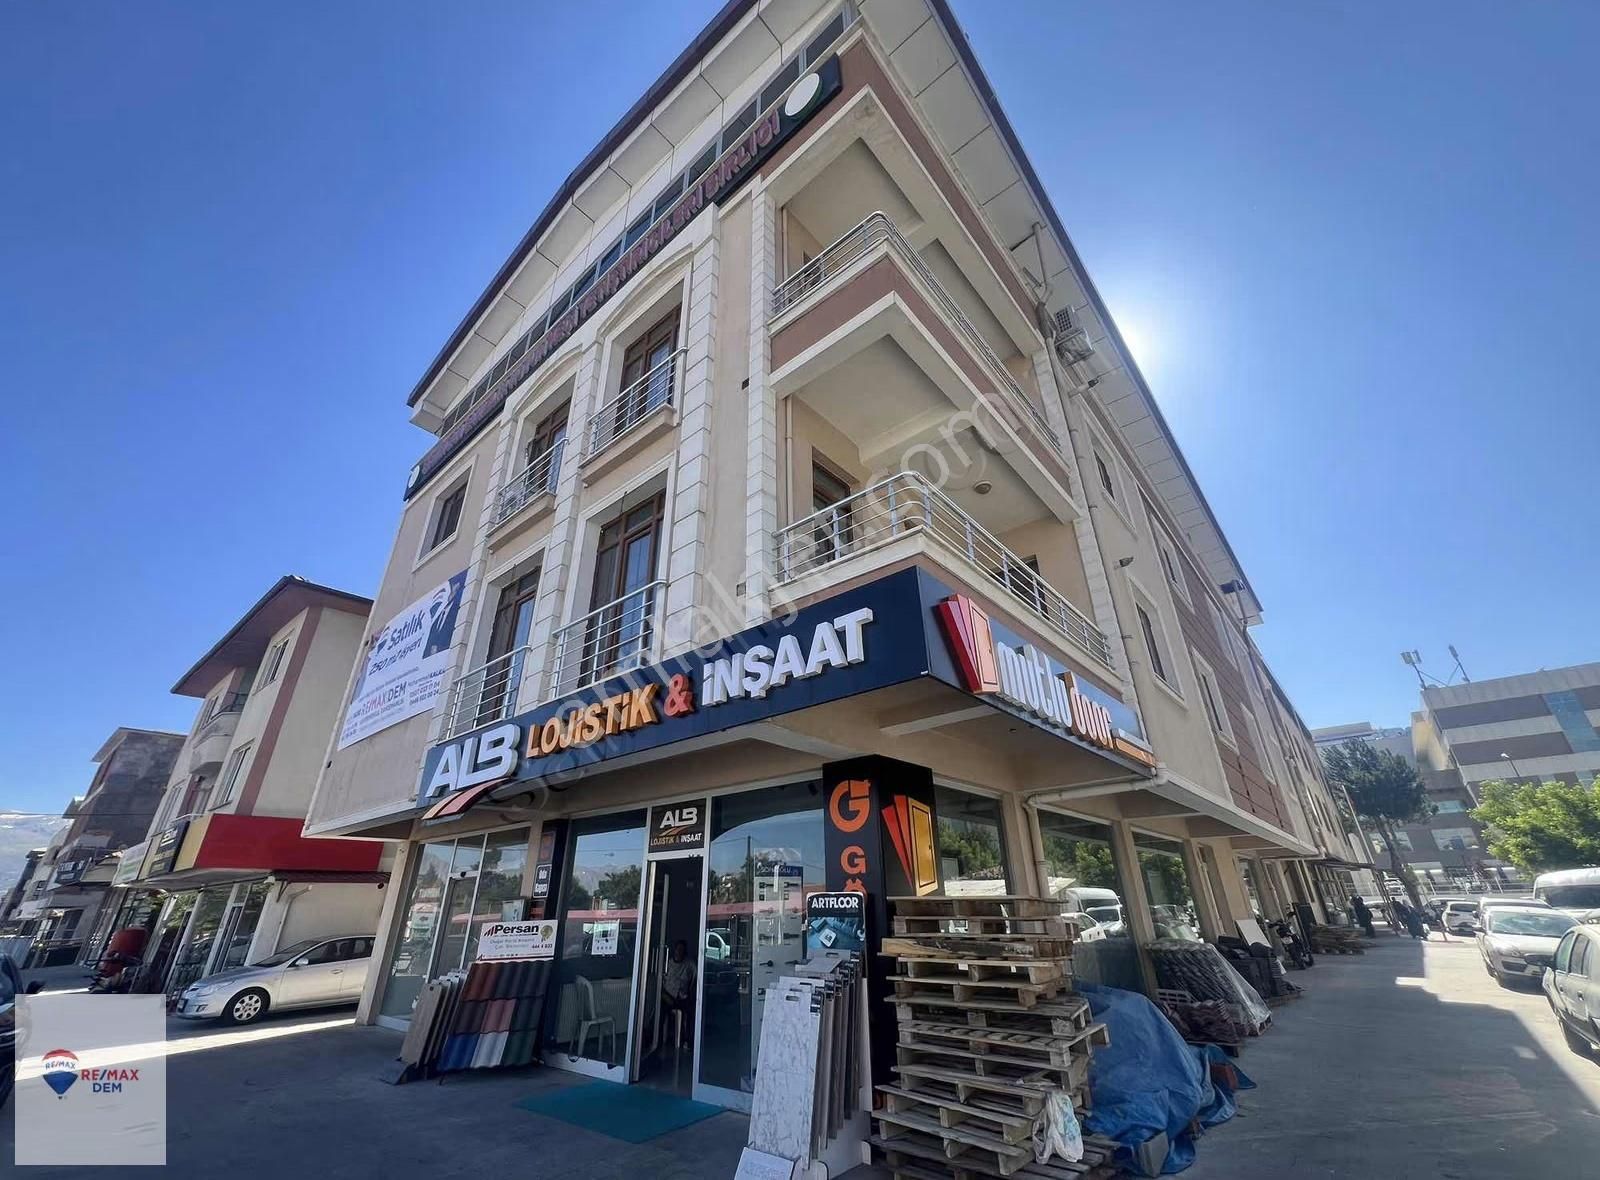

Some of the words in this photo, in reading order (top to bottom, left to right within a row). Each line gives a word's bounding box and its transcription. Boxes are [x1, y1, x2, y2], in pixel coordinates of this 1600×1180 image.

[387, 609, 425, 651] Satılık
[425, 723, 521, 798] ALB
[664, 673, 695, 718] &
[702, 607, 873, 706] İNŞAAT
[659, 807, 698, 829] ALB
[811, 896, 859, 909] ARTFLOOR
[494, 924, 539, 934] Persan
